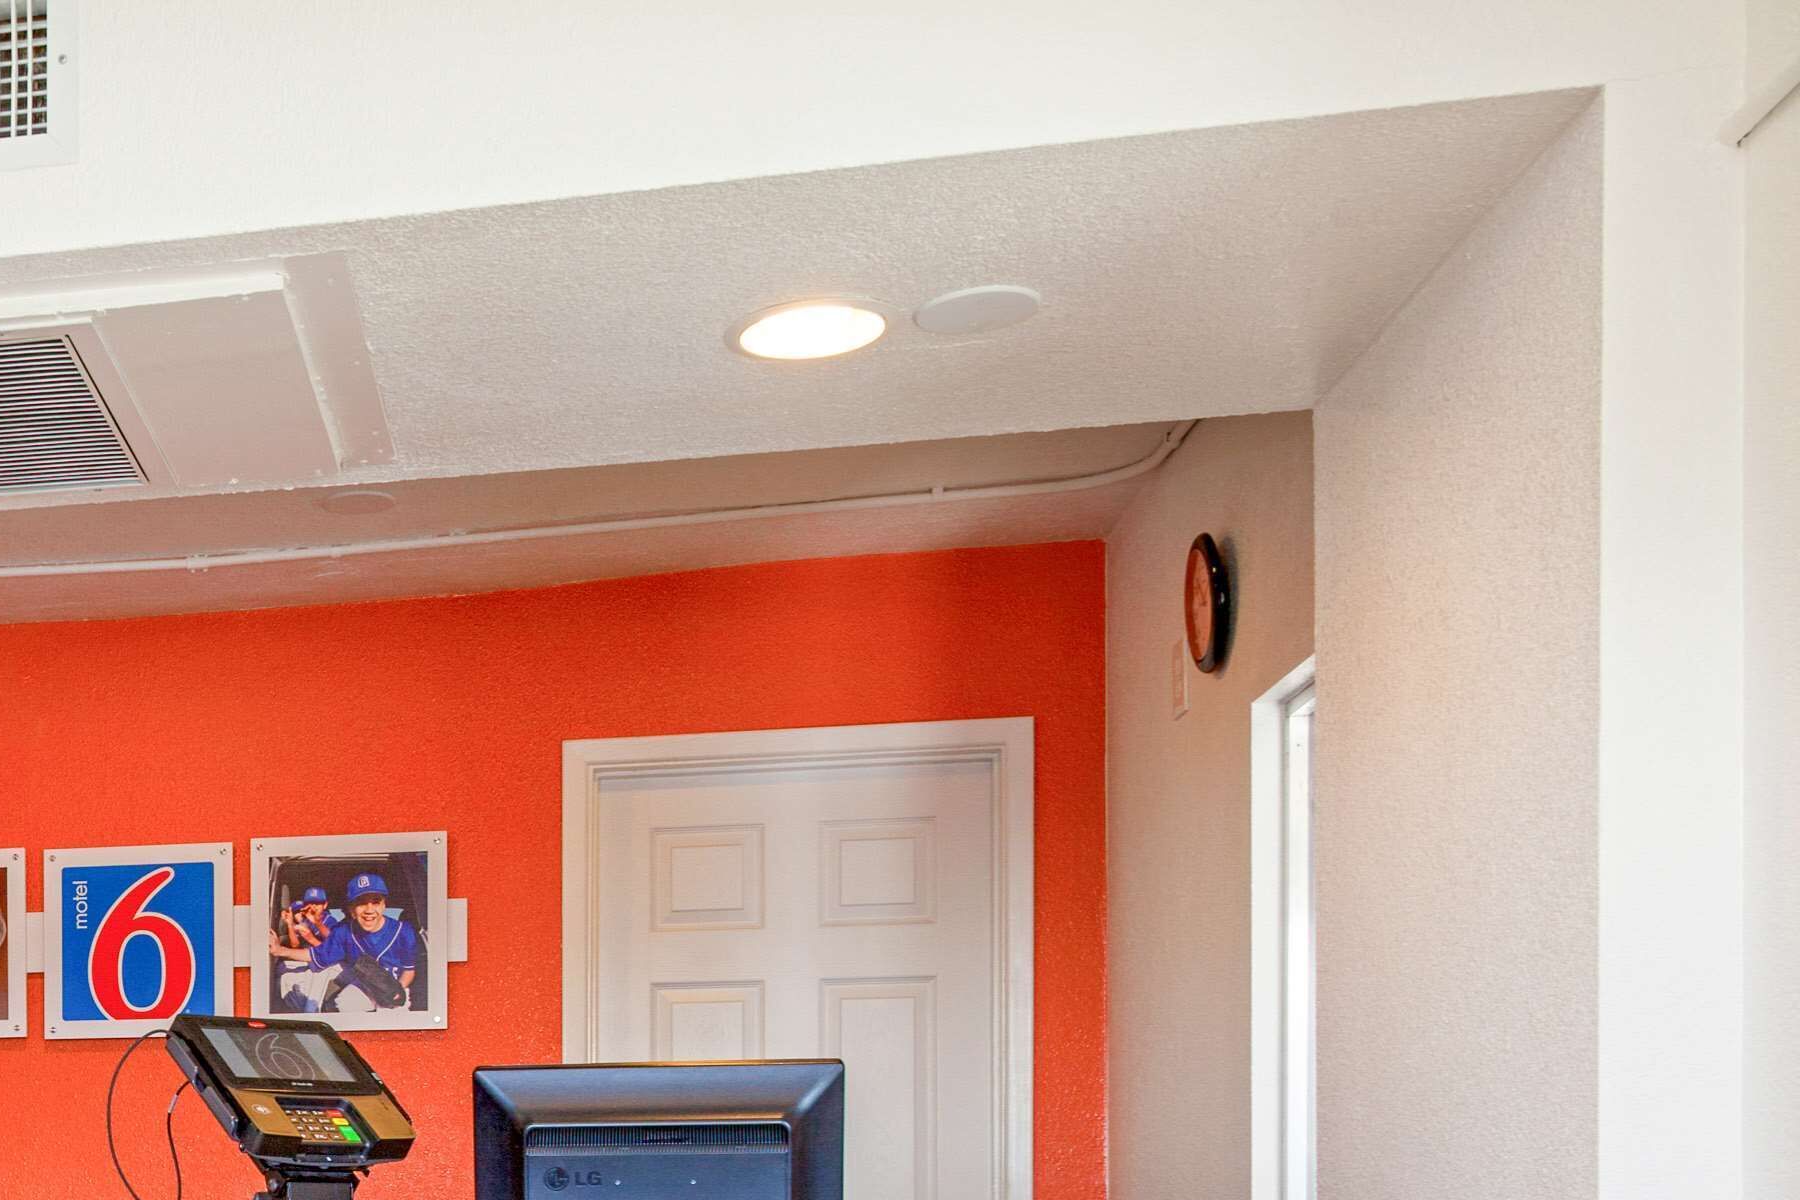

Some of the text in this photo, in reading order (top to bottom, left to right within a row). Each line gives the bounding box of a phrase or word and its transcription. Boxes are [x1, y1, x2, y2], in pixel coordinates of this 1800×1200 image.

[72, 866, 196, 1021] motel 6
[574, 1171, 603, 1187] LG
